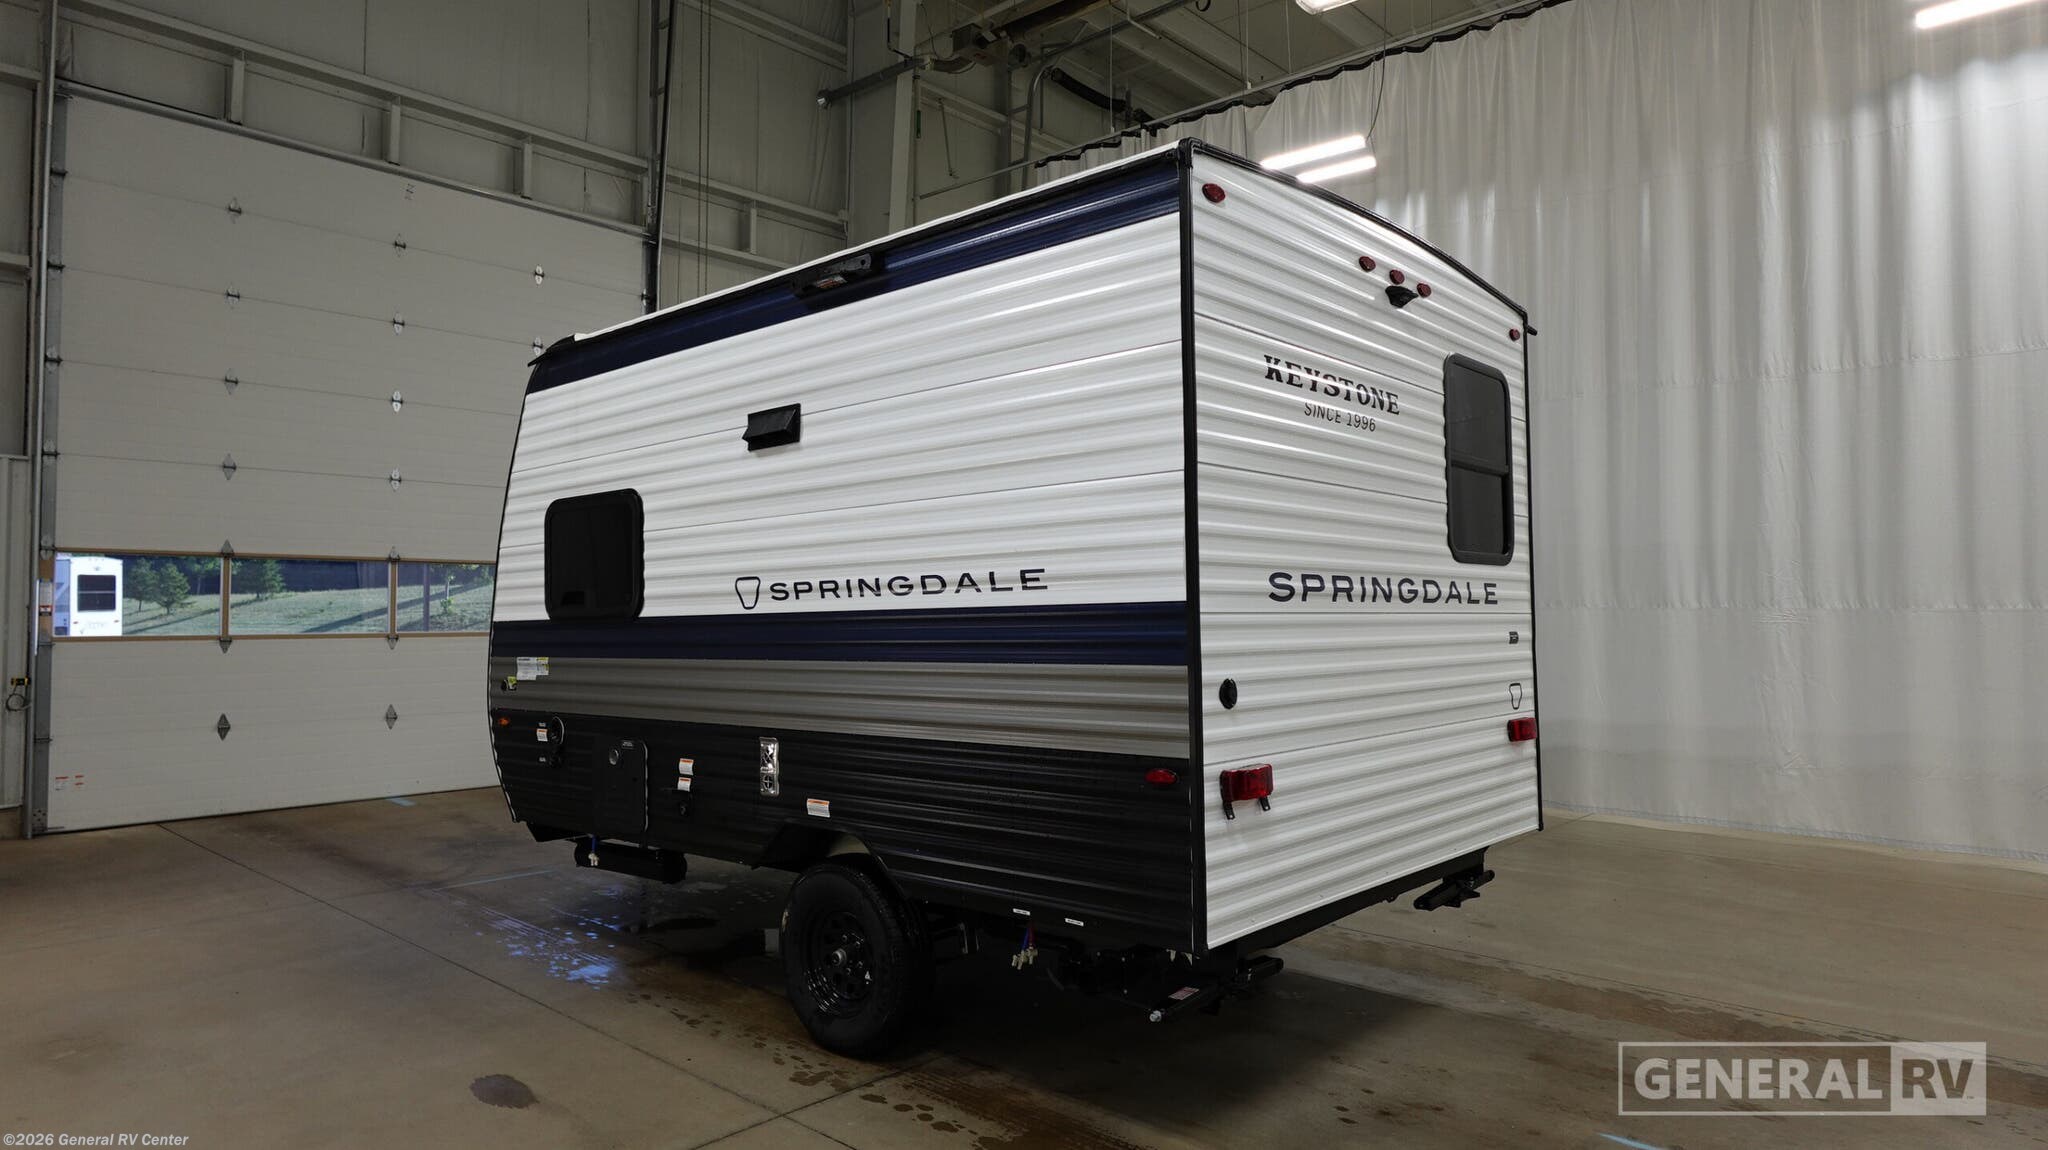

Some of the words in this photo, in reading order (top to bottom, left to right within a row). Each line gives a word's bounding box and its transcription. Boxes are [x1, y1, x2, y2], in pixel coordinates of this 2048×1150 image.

[1264, 355, 1400, 415] KEYSTONE
[1304, 402, 1341, 424] SINCE
[1346, 412, 1376, 432] 1996
[769, 568, 1048, 600] SPRINGDALE
[1268, 571, 1498, 604] SPRINGDALE
